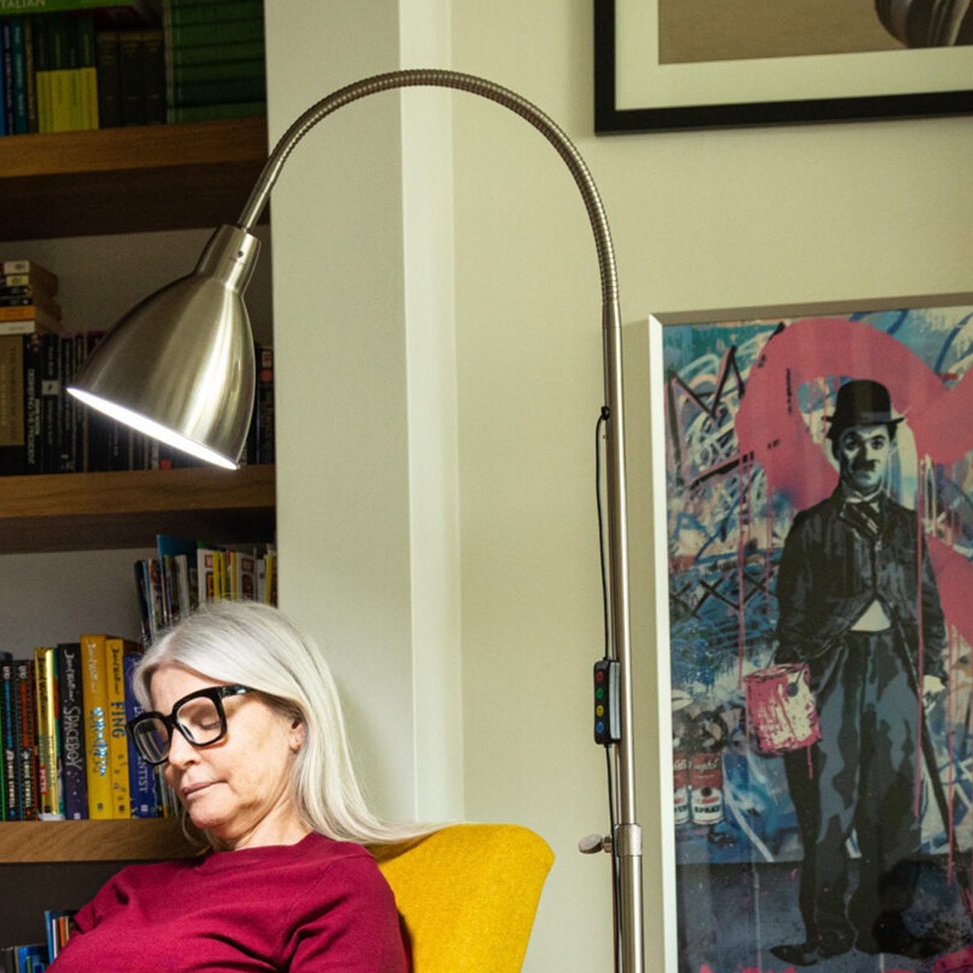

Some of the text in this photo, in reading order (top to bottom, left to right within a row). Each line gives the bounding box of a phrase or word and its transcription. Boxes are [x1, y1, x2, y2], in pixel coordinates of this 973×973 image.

[63, 706, 83, 770] SPACEBOY
[111, 701, 127, 738] FING
[137, 756, 149, 793] ENTIST
